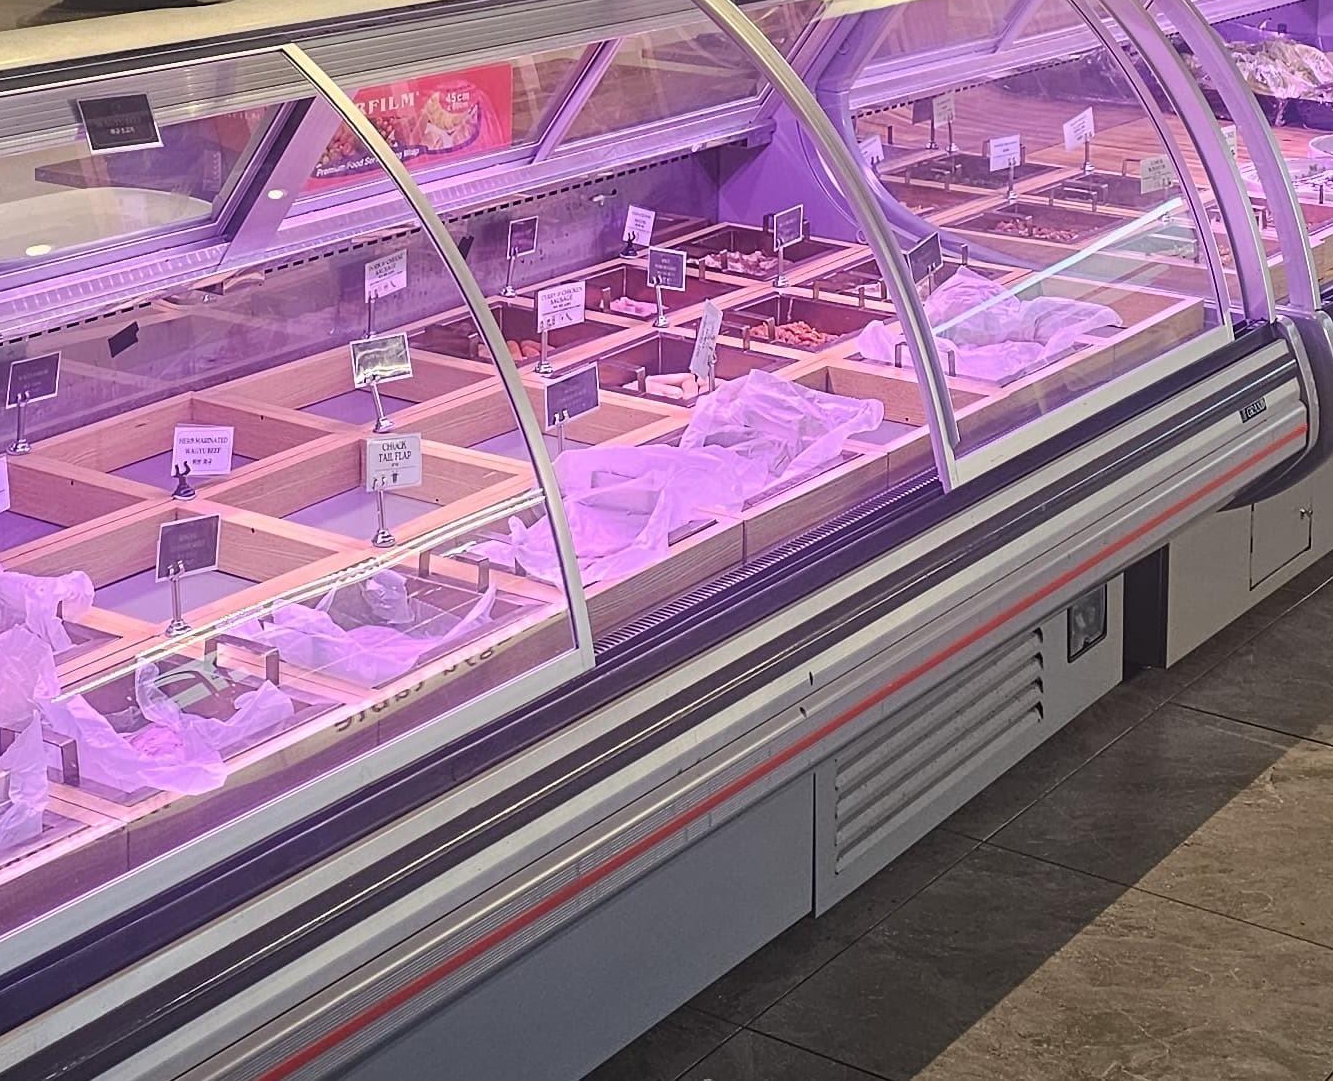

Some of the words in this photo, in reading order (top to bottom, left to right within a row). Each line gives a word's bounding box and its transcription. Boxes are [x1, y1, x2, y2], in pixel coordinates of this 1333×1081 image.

[355, 92, 415, 116] RFILM
[382, 440, 407, 451] CHUCK
[378, 452, 394, 463] TAIL
[394, 450, 412, 461] FLAP
